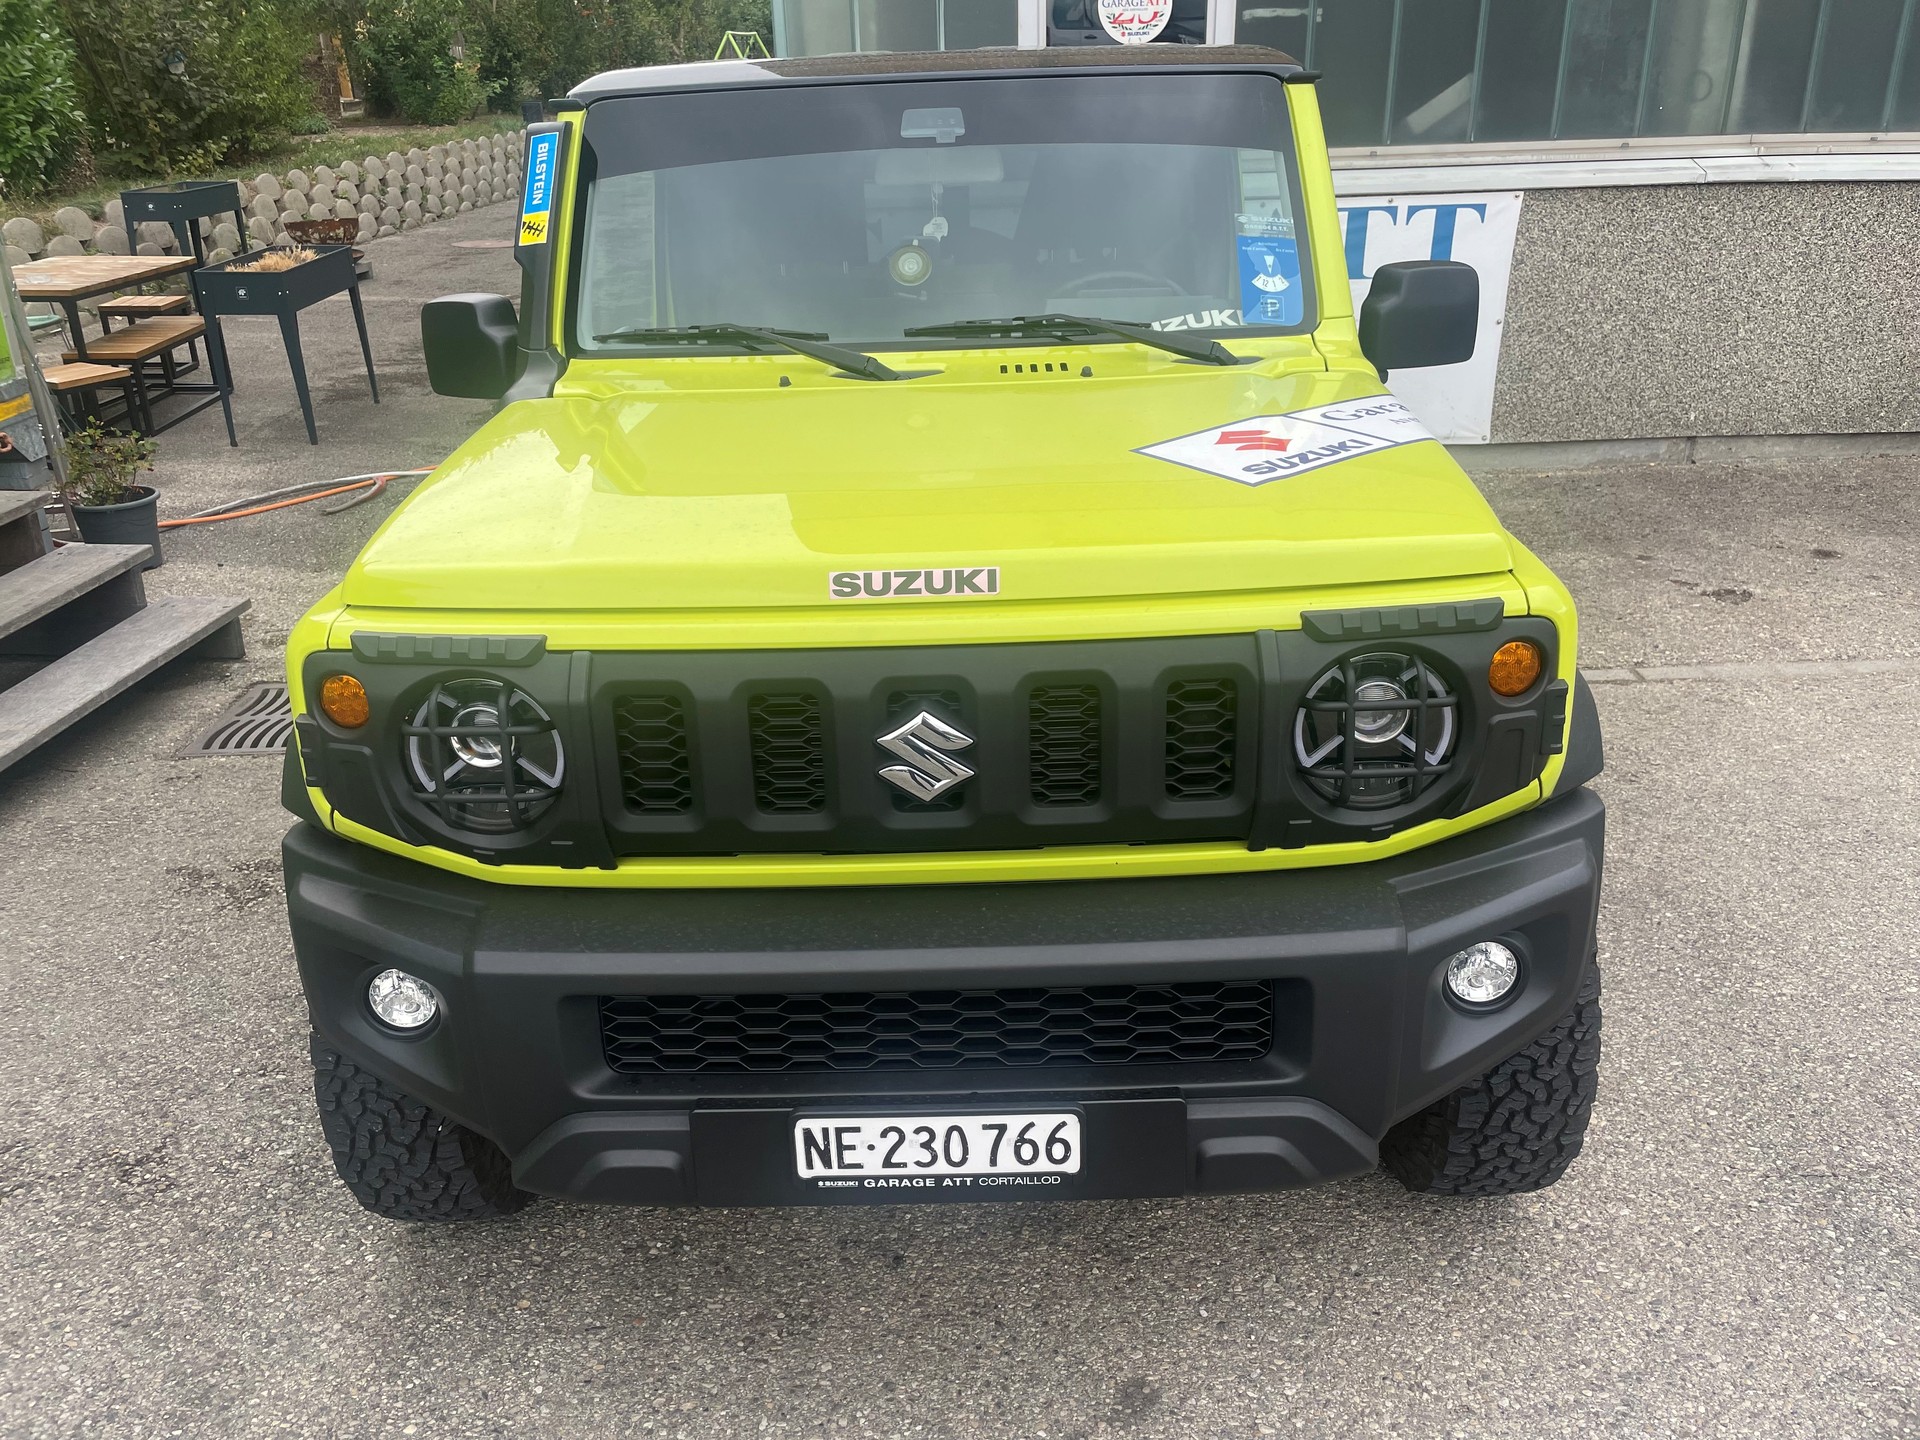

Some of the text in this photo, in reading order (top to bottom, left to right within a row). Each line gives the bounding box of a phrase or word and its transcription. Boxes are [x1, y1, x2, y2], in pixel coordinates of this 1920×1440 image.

[532, 142, 549, 205] BILSTEIN
[1242, 438, 1373, 475] SUZUKI
[832, 568, 997, 598] SUZUKI
[981, 1120, 1072, 1167] 766
[824, 1175, 1061, 1188] SUZUKI GARAGE ATT CORTAILLOD
